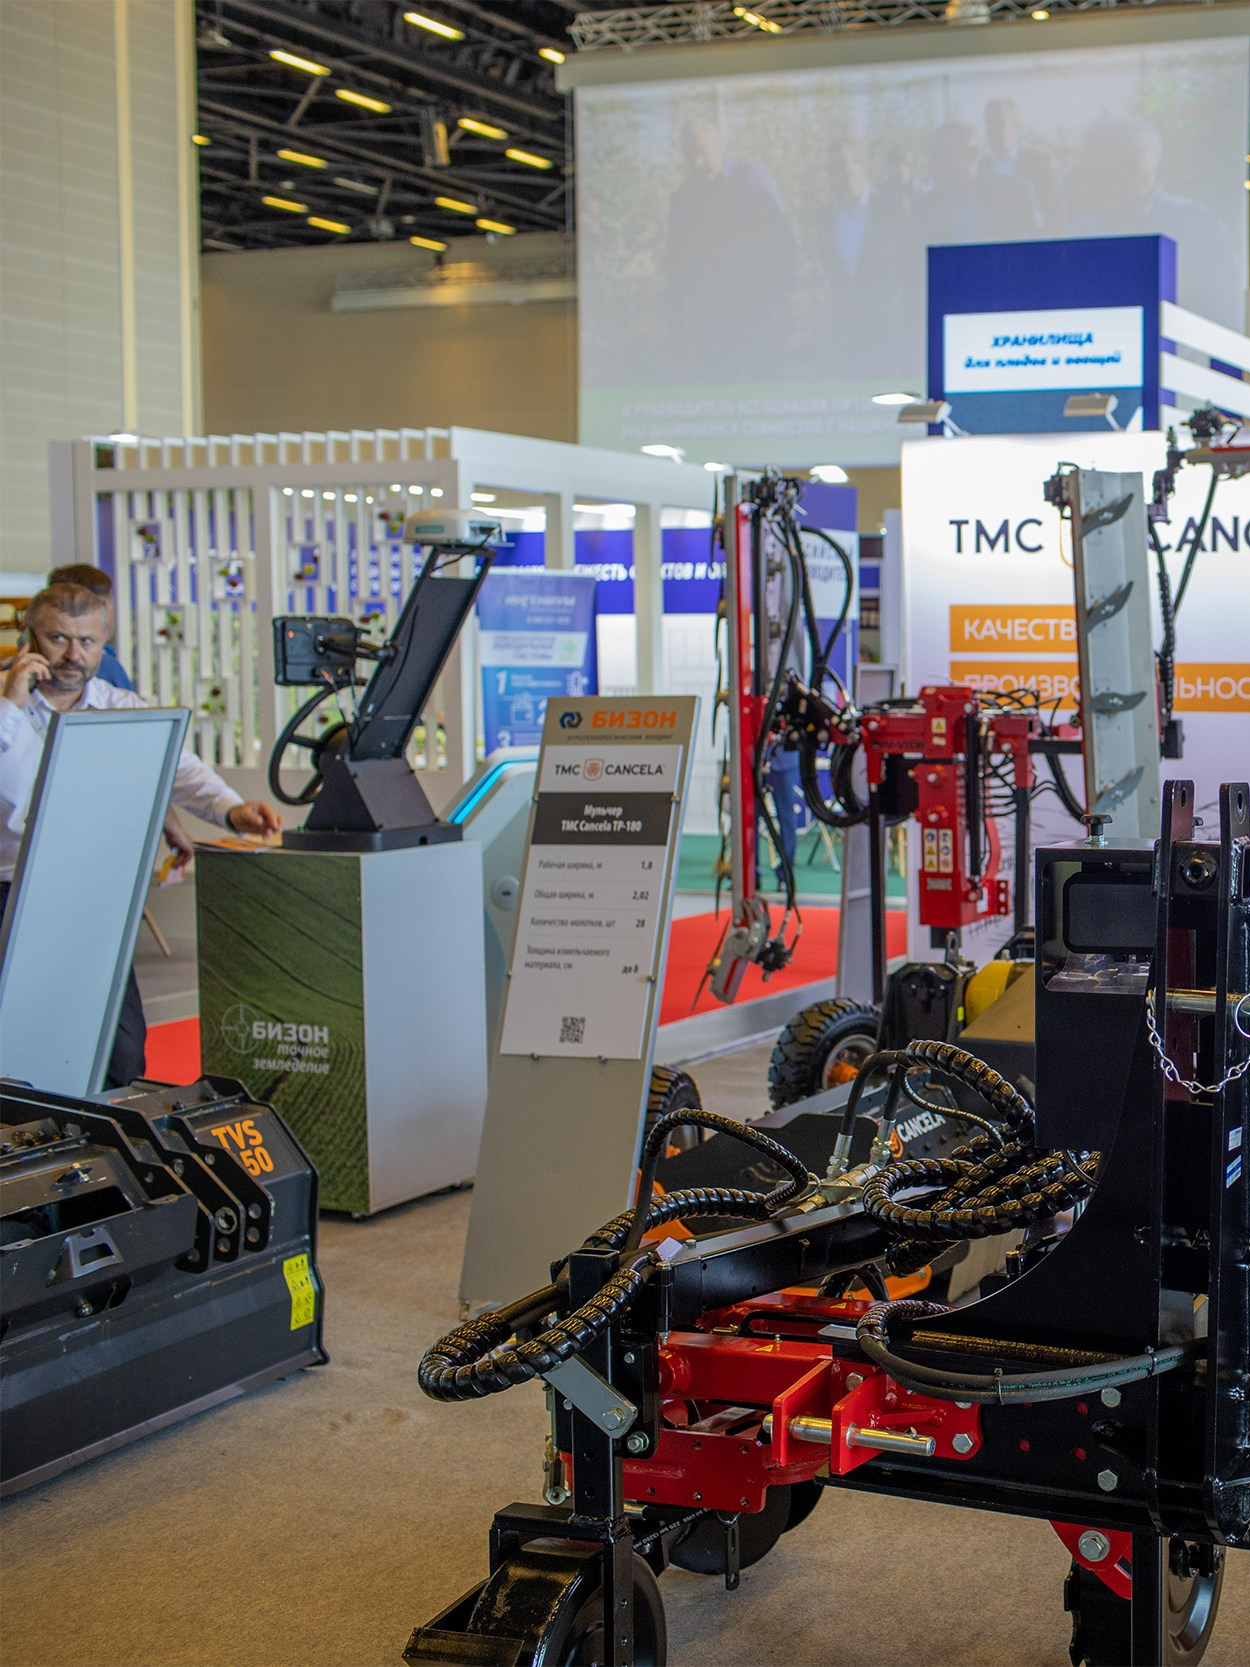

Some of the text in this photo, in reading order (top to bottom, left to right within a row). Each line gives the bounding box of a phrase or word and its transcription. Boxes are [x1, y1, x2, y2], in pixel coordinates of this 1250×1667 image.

[991, 332, 1093, 347] ХРАНИЛИЩА
[965, 355, 990, 368] для
[1052, 357, 1060, 366] и
[949, 518, 1044, 553] TMC
[964, 618, 1079, 641] КАЧЕСТВ
[592, 710, 677, 729] БИЗОН
[567, 733, 642, 741] АГРОТЕХНОЛОГИЧЕСКИЙ
[555, 764, 663, 775] TMC CANCELA
[584, 804, 623, 817] Мульчер
[561, 820, 642, 832] TMC Cancela TP-180
[641, 861, 652, 870] 1,8
[534, 889, 557, 900] Общая
[632, 890, 649, 901] 2,02
[635, 919, 645, 928] 28
[622, 965, 633, 974] до
[252, 1021, 329, 1044] БИЗОН
[277, 1044, 329, 1058] точное
[253, 1057, 330, 1075] земледелие
[896, 1111, 946, 1143] CANCELA
[211, 1120, 263, 1151] TVS
